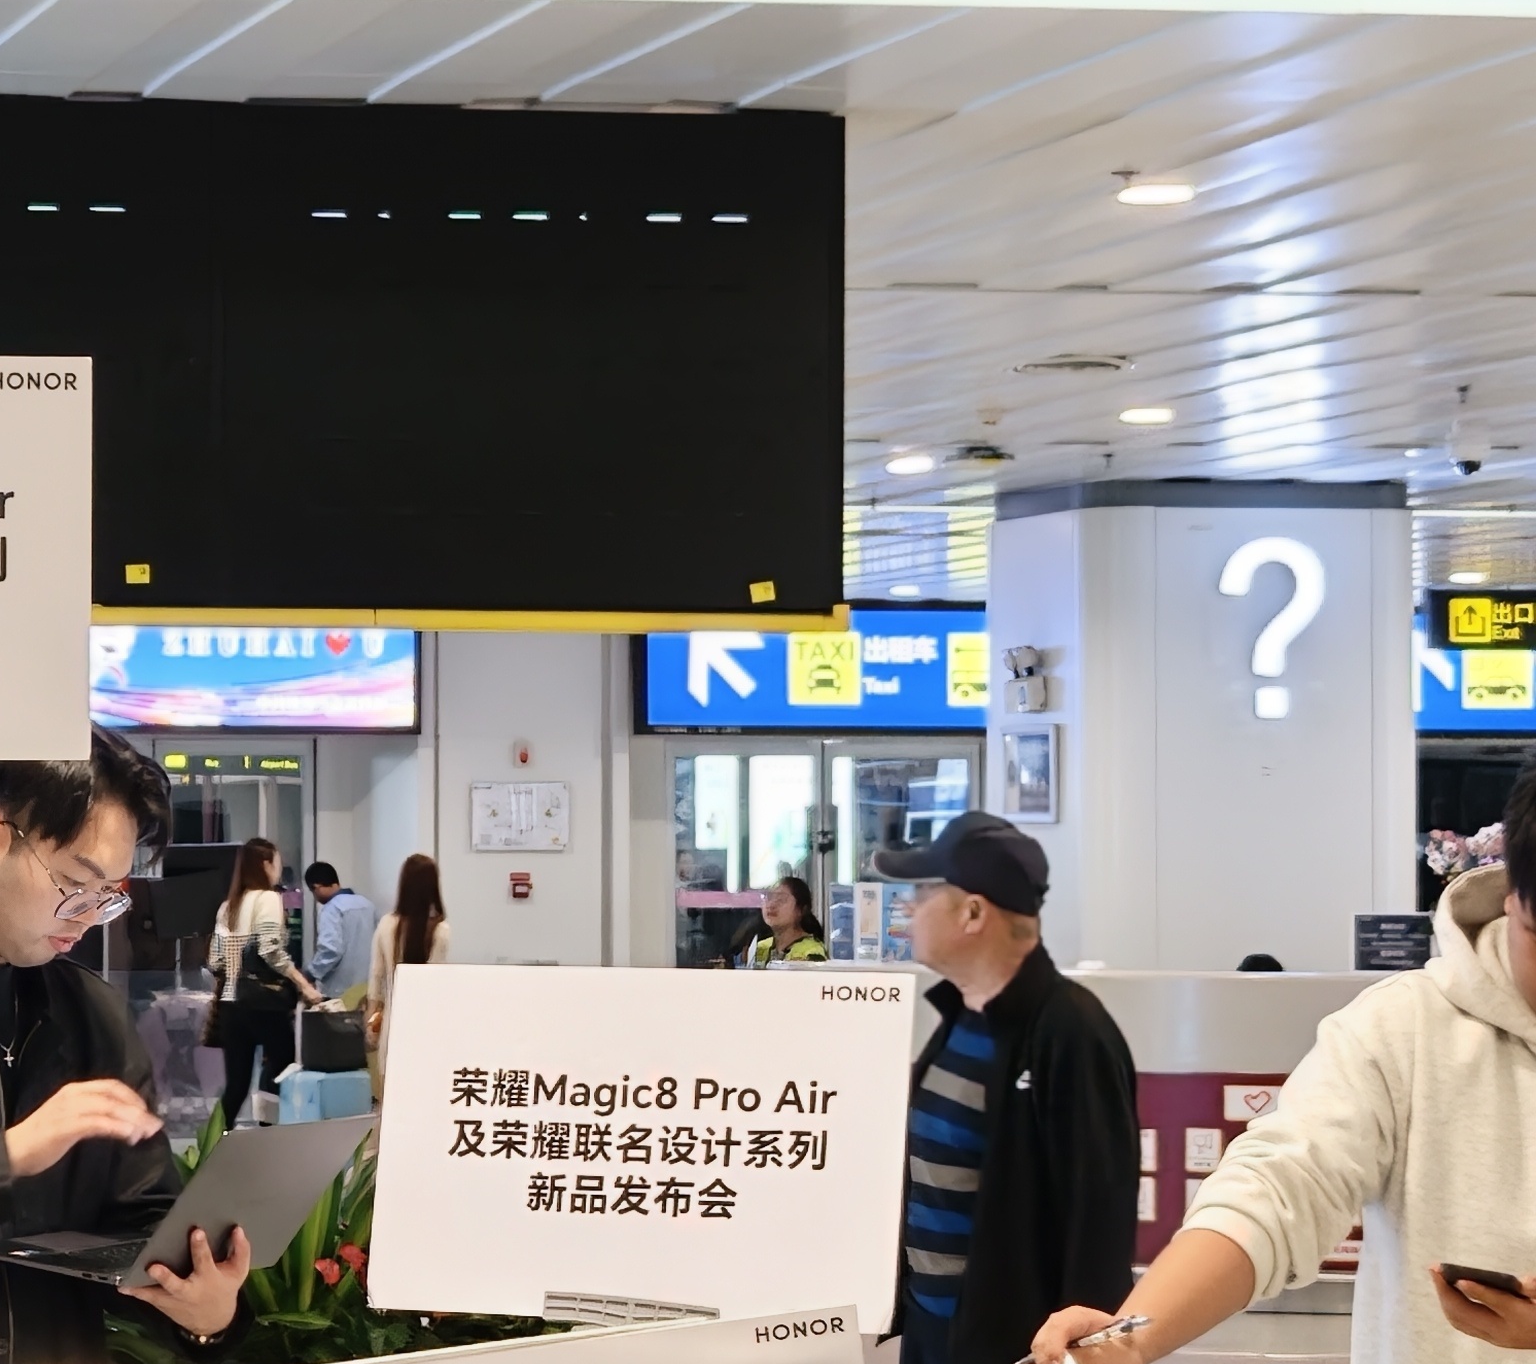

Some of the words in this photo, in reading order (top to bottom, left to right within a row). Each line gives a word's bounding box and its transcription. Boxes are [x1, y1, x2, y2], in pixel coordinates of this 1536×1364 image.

[794, 641, 854, 661] TAXI
[821, 985, 901, 1003] HONOR
[449, 1066, 678, 1117] 荣耀Magic8
[693, 1077, 762, 1113] Pro
[774, 1080, 838, 1115] Air
[447, 1119, 828, 1172] 及荣耀联名设计系列
[526, 1171, 738, 1220] 新品发布会
[754, 1316, 845, 1344] HONOR
